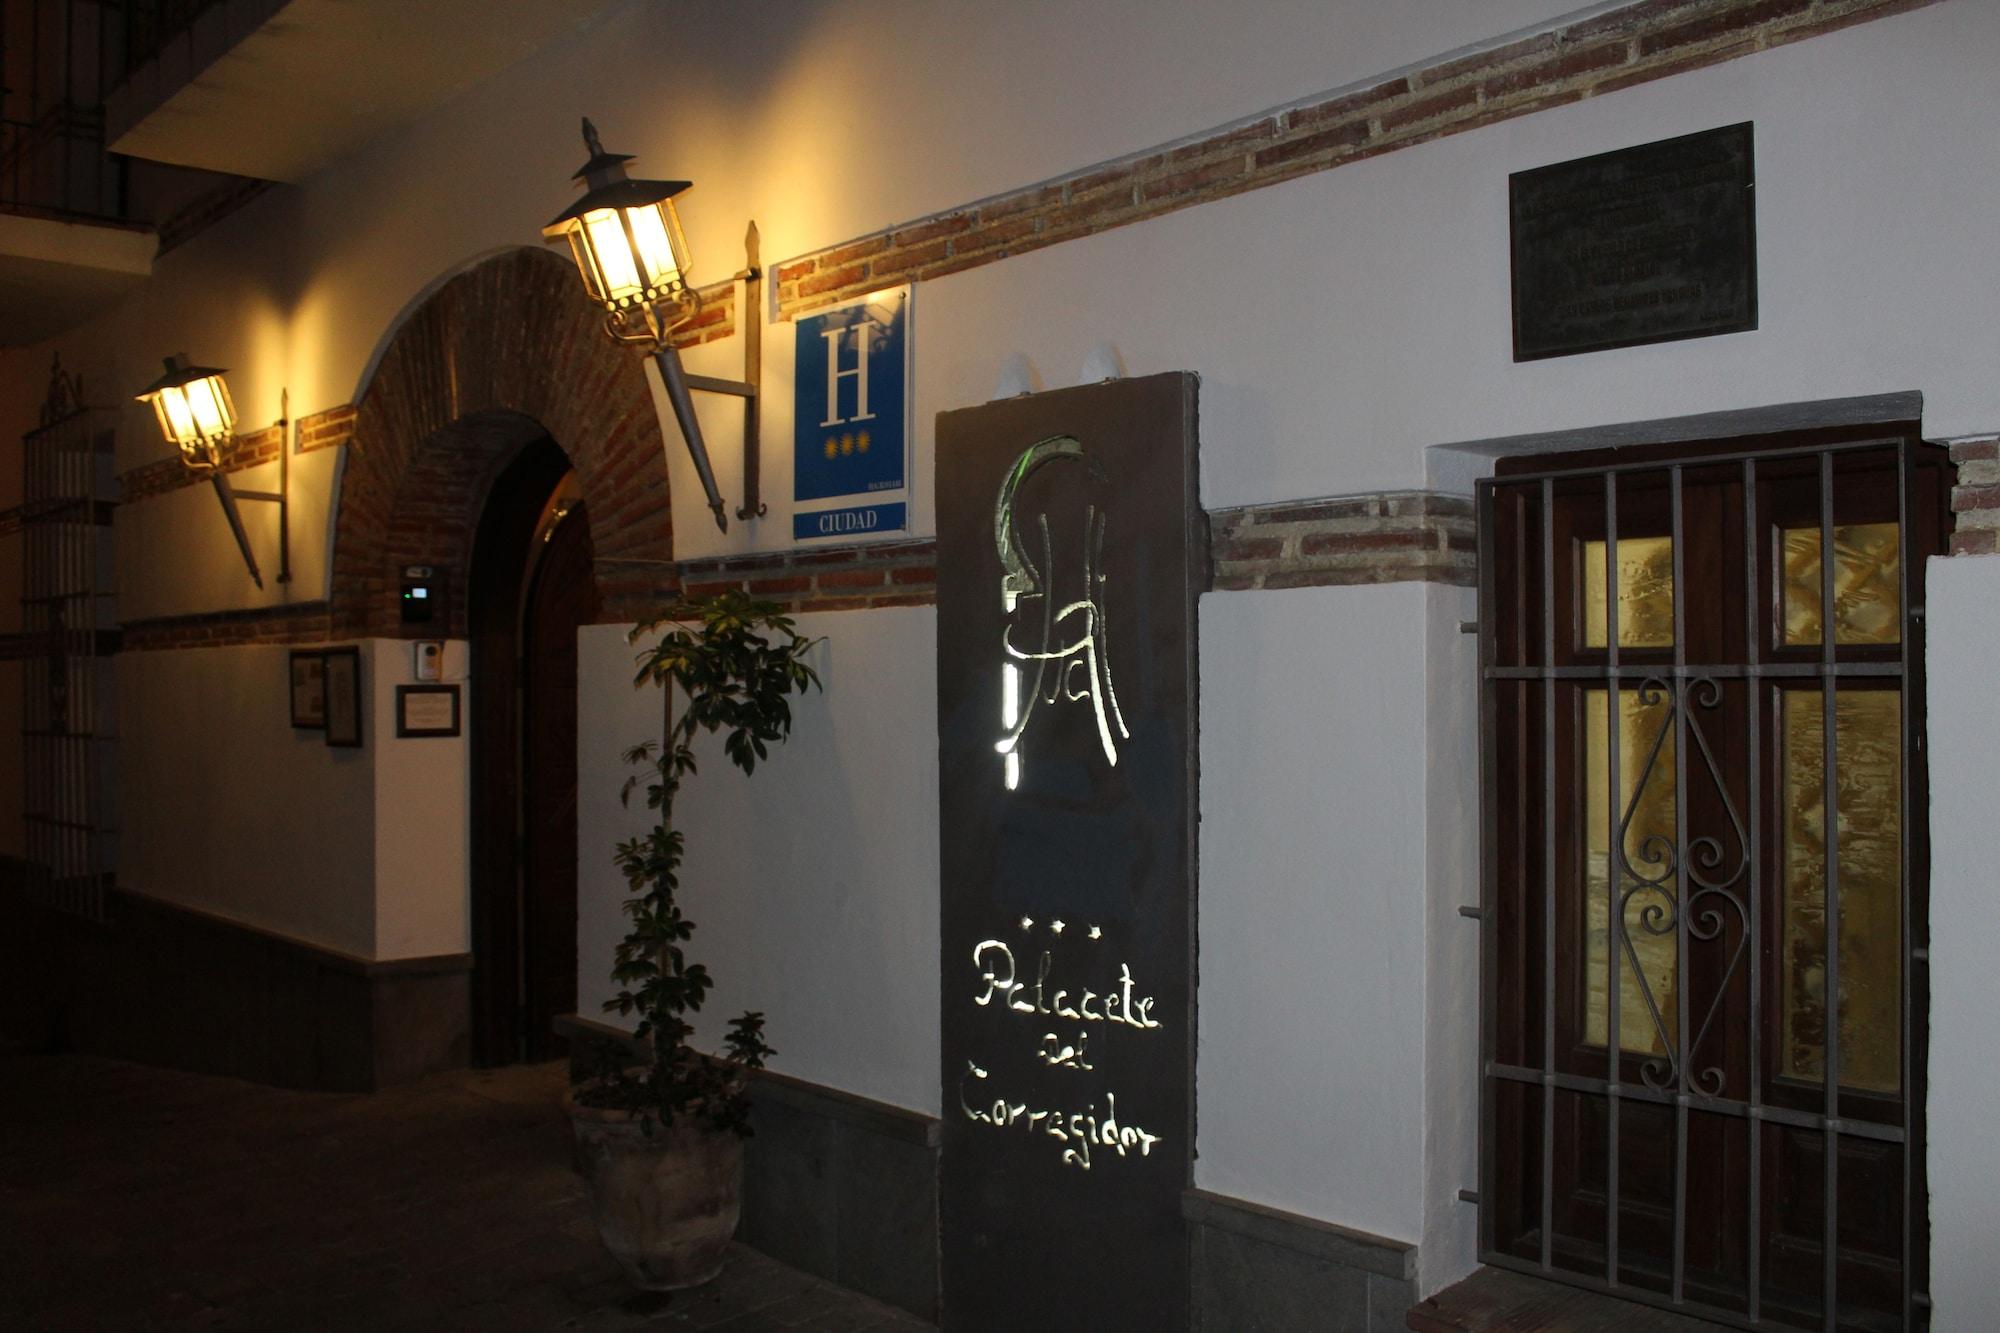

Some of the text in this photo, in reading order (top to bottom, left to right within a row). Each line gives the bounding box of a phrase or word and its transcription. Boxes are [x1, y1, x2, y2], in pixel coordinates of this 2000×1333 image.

[820, 320, 876, 428] H
[819, 509, 877, 534] CIUDAD
[973, 939, 1163, 1029] Palacete
[959, 1059, 1162, 1171] Corregidor
